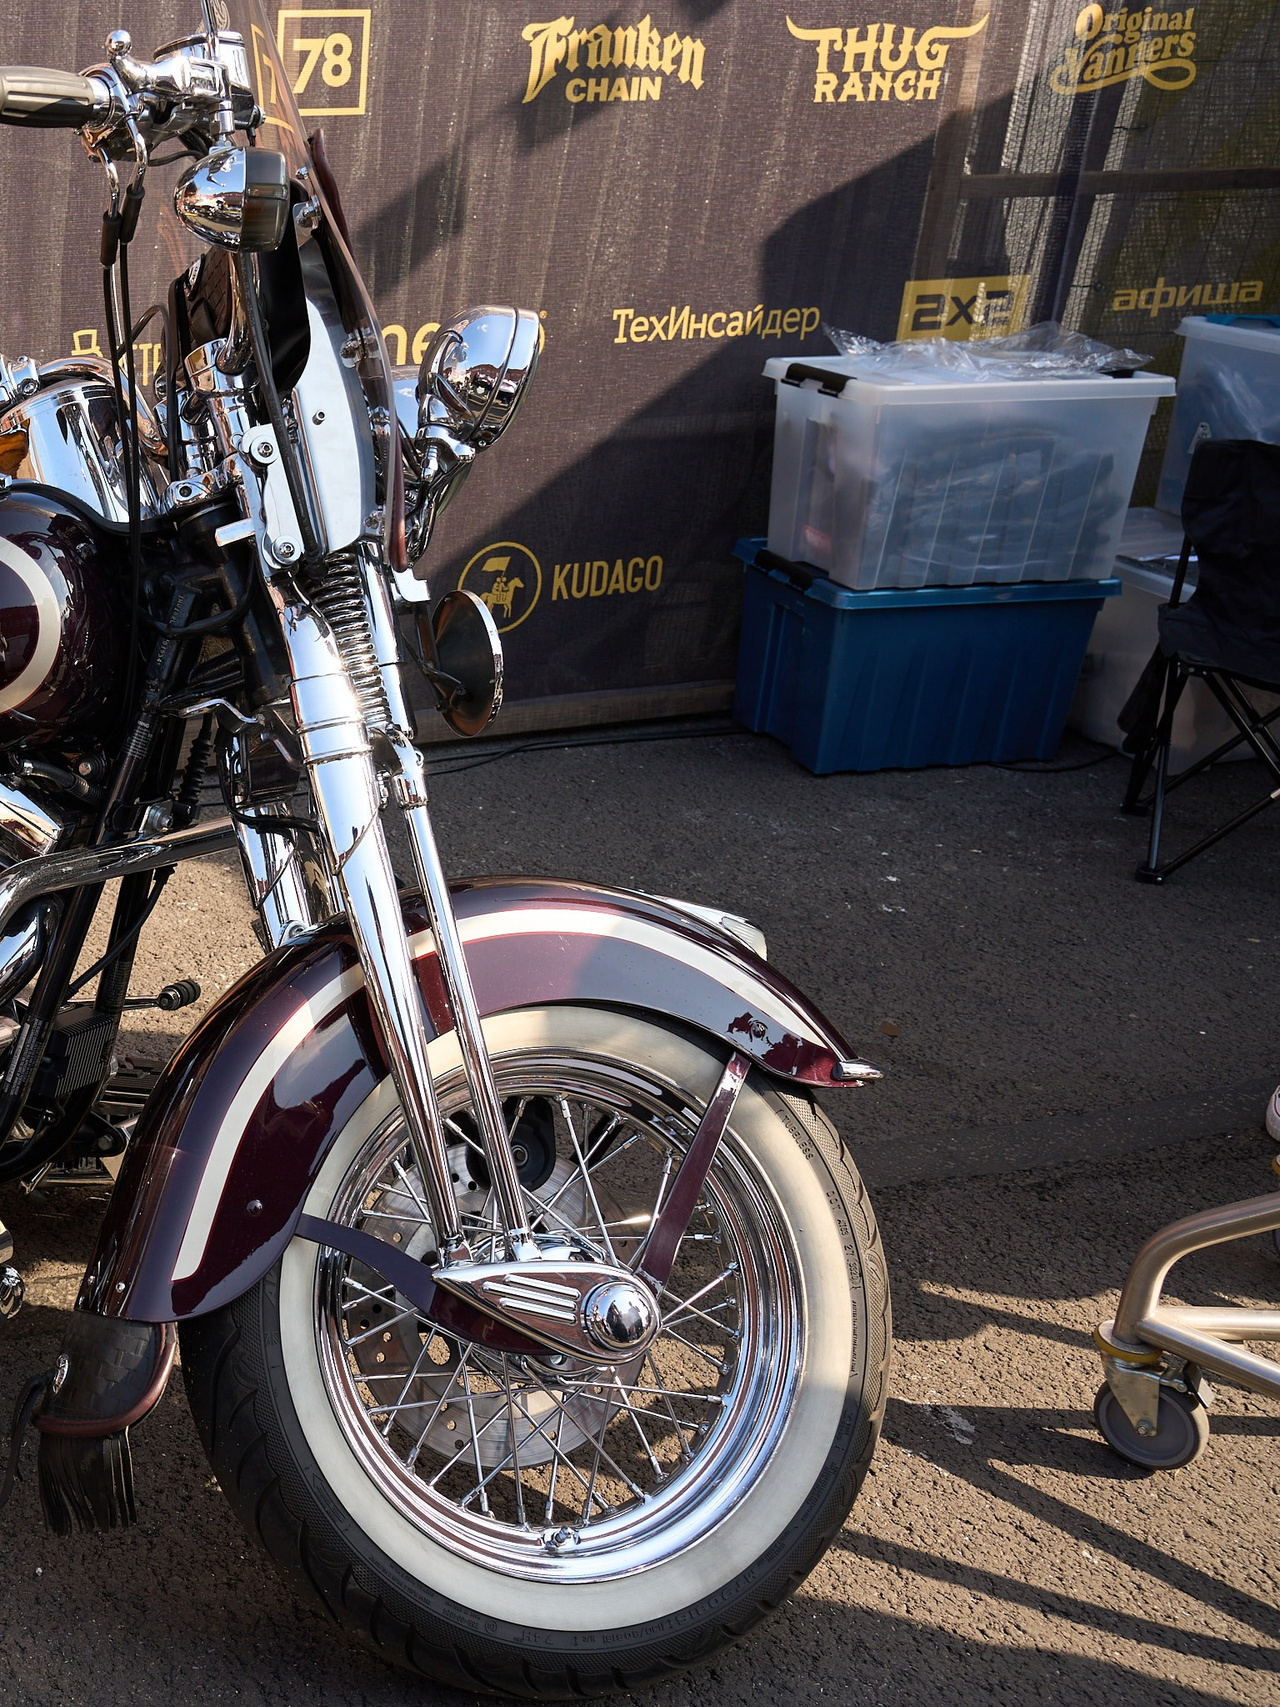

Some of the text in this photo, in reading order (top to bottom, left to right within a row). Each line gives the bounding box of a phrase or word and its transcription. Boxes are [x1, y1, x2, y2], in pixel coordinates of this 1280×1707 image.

[785, 12, 990, 73] THUG
[1075, 3, 1195, 43] Original
[292, 32, 353, 94] 78
[521, 14, 706, 104] Franken
[1050, 31, 1196, 94] Vanners
[564, 76, 662, 103] CHAIN
[813, 69, 942, 102] RANCH
[1112, 277, 1264, 317] афиша
[612, 304, 820, 344] ТехИнсайдер
[552, 555, 664, 600] KUDAGO
